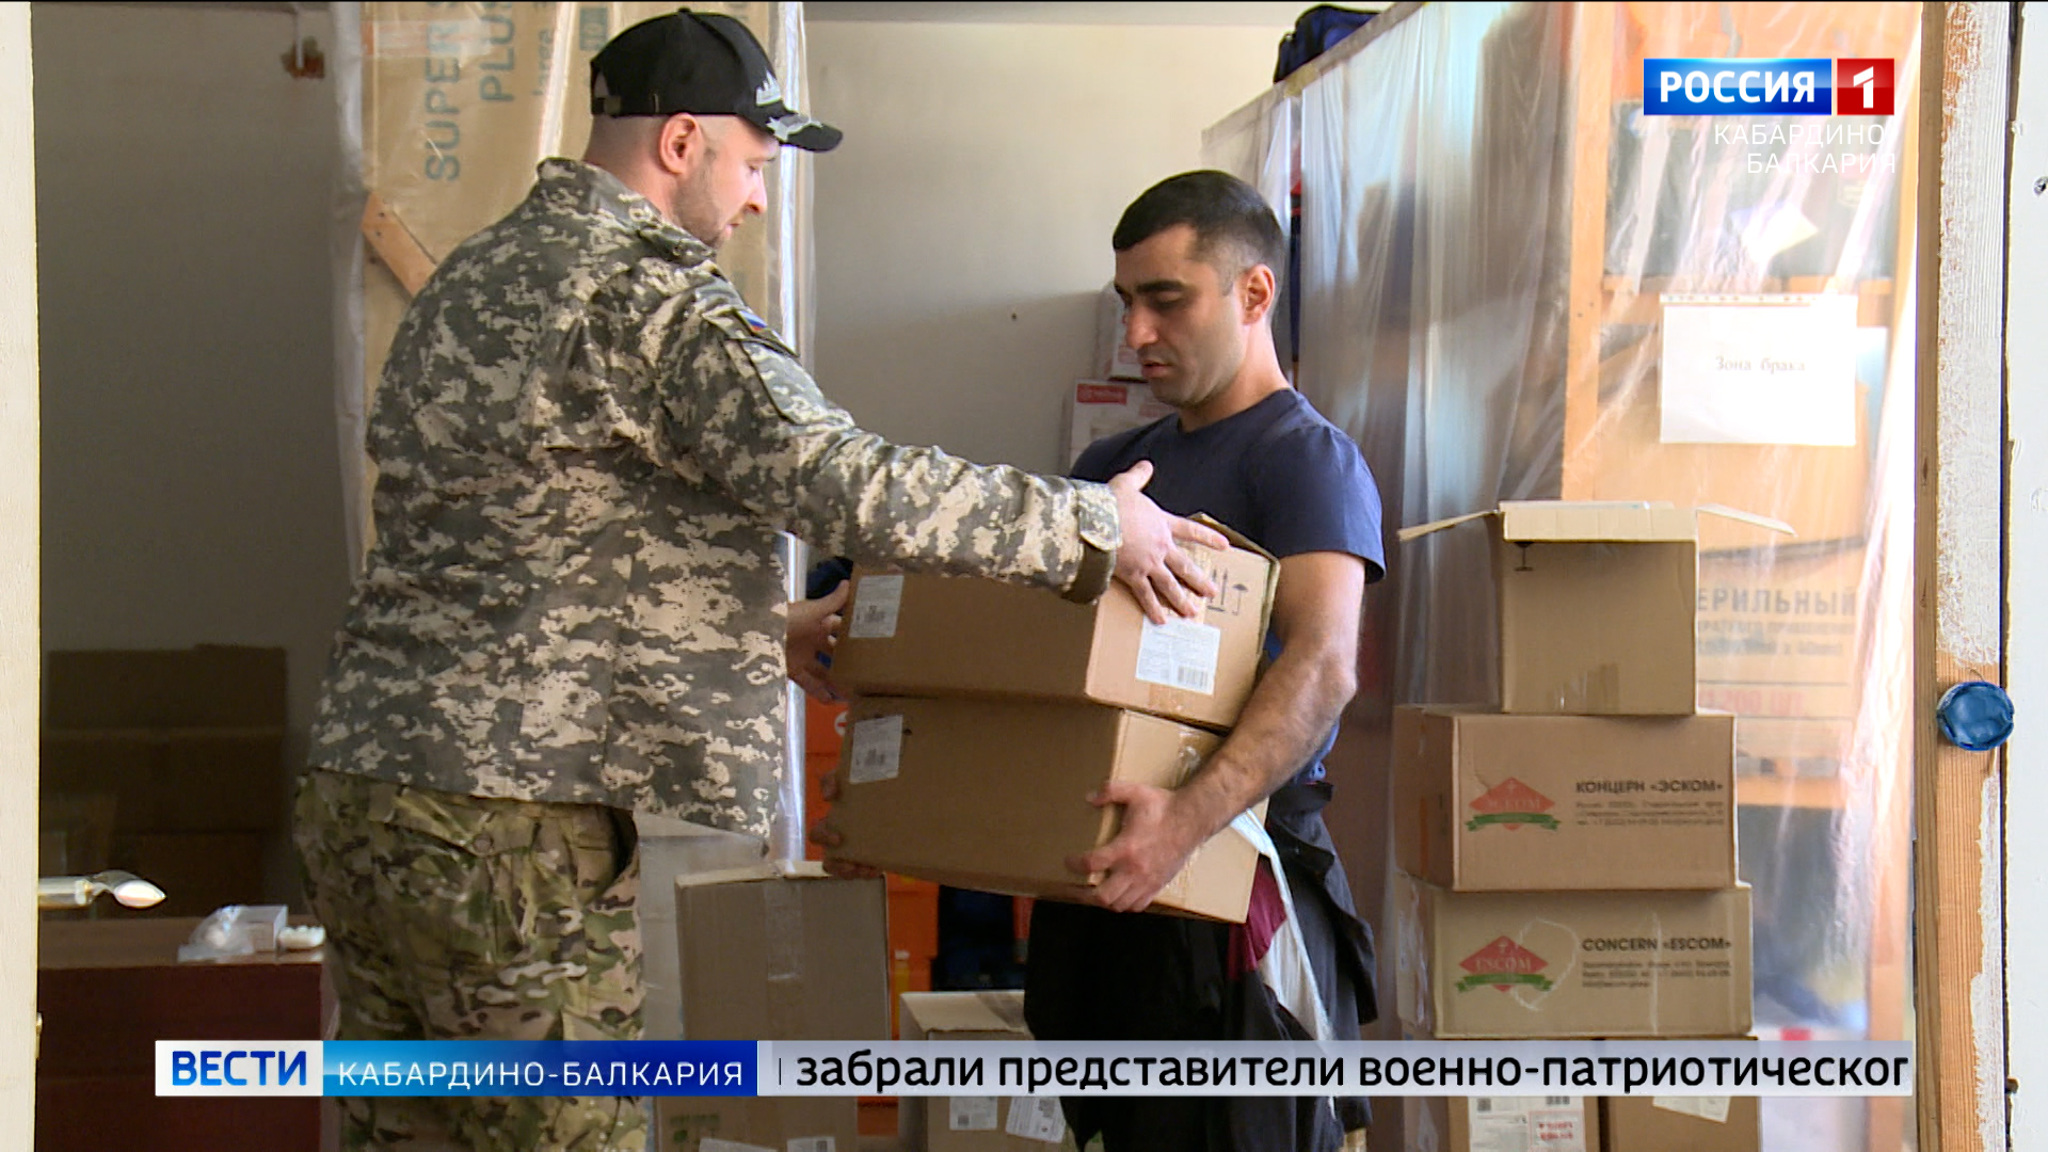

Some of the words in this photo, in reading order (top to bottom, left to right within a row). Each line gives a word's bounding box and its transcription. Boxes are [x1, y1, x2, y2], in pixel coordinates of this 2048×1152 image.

[424, 20, 460, 182] SUPER
[1715, 355, 1752, 371] Зона
[1698, 585, 1856, 616] ЕРИЛЬНЫЙ
[1575, 780, 1645, 795] КОНЦЕРН
[1649, 779, 1724, 793] «ЭСКОМ»
[1582, 937, 1658, 952] CONCERN
[1663, 937, 1732, 951] «ESCOM»
